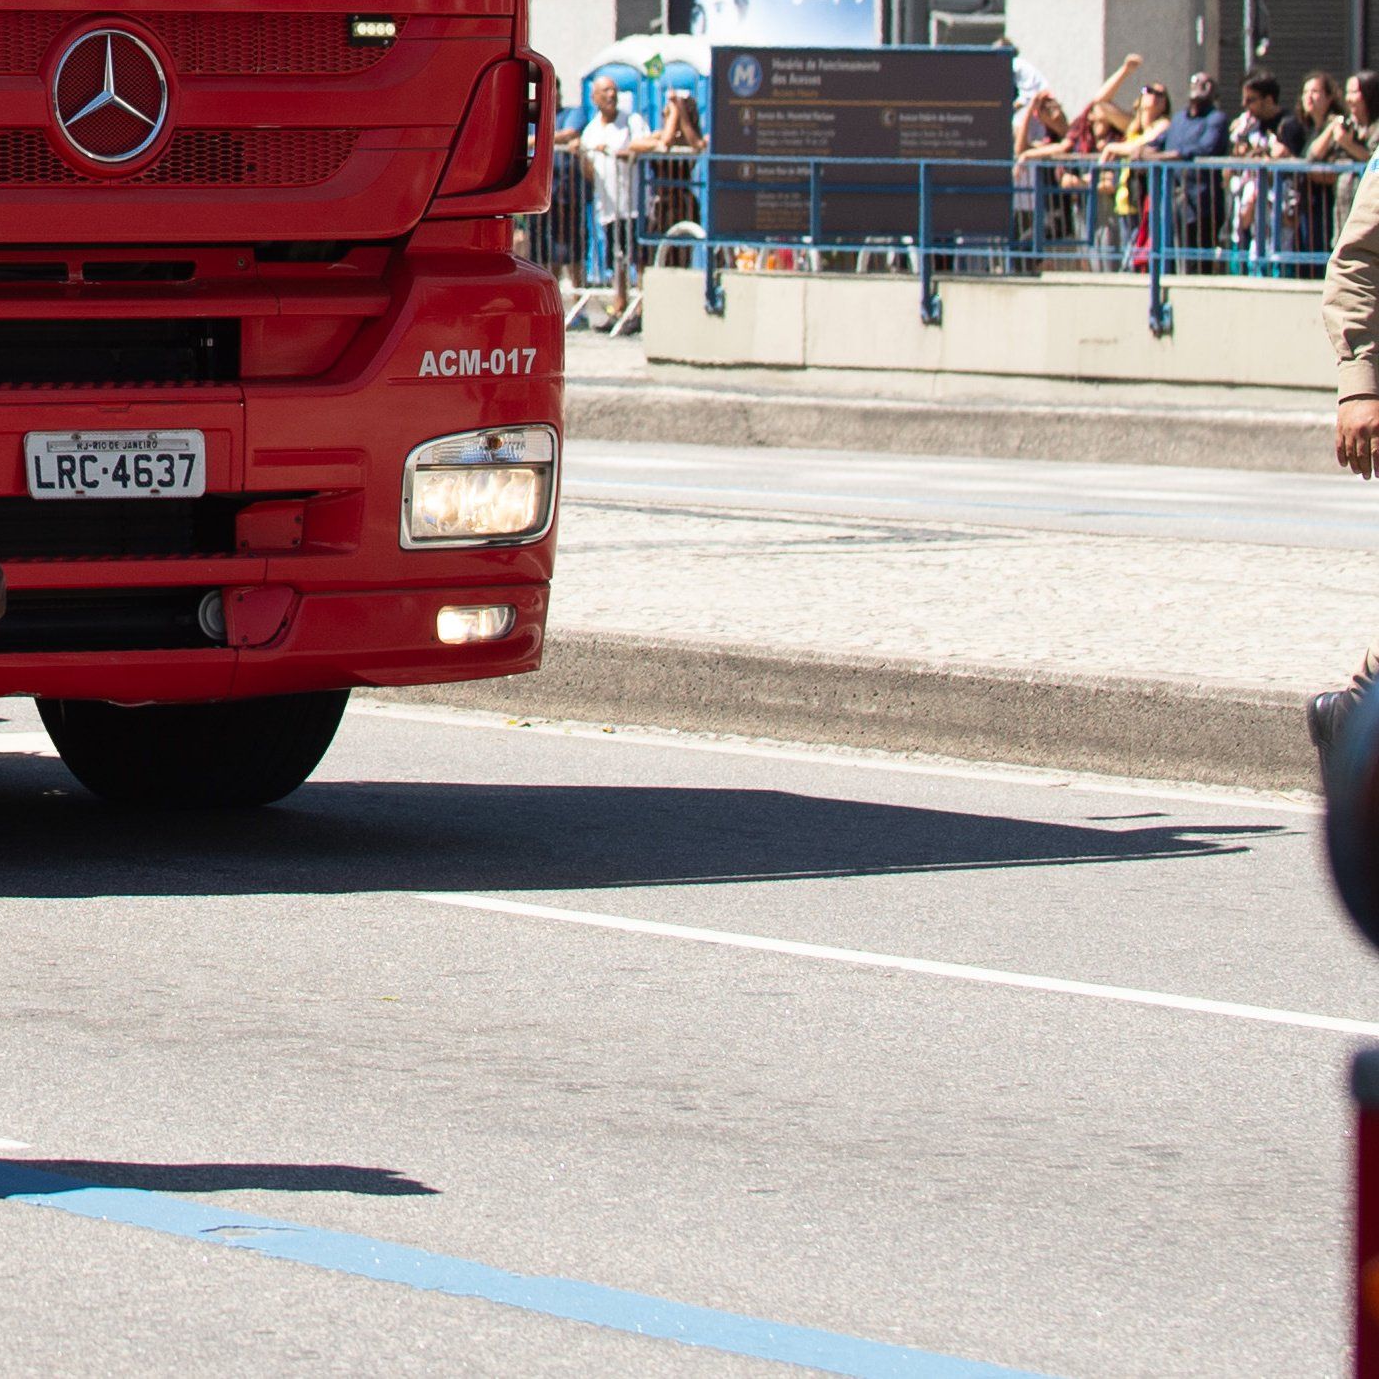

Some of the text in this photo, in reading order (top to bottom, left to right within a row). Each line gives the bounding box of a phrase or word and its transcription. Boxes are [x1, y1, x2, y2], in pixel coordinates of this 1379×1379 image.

[418, 347, 537, 377] ACM-017
[108, 441, 119, 450] DE
[122, 439, 158, 450] JANEIRO
